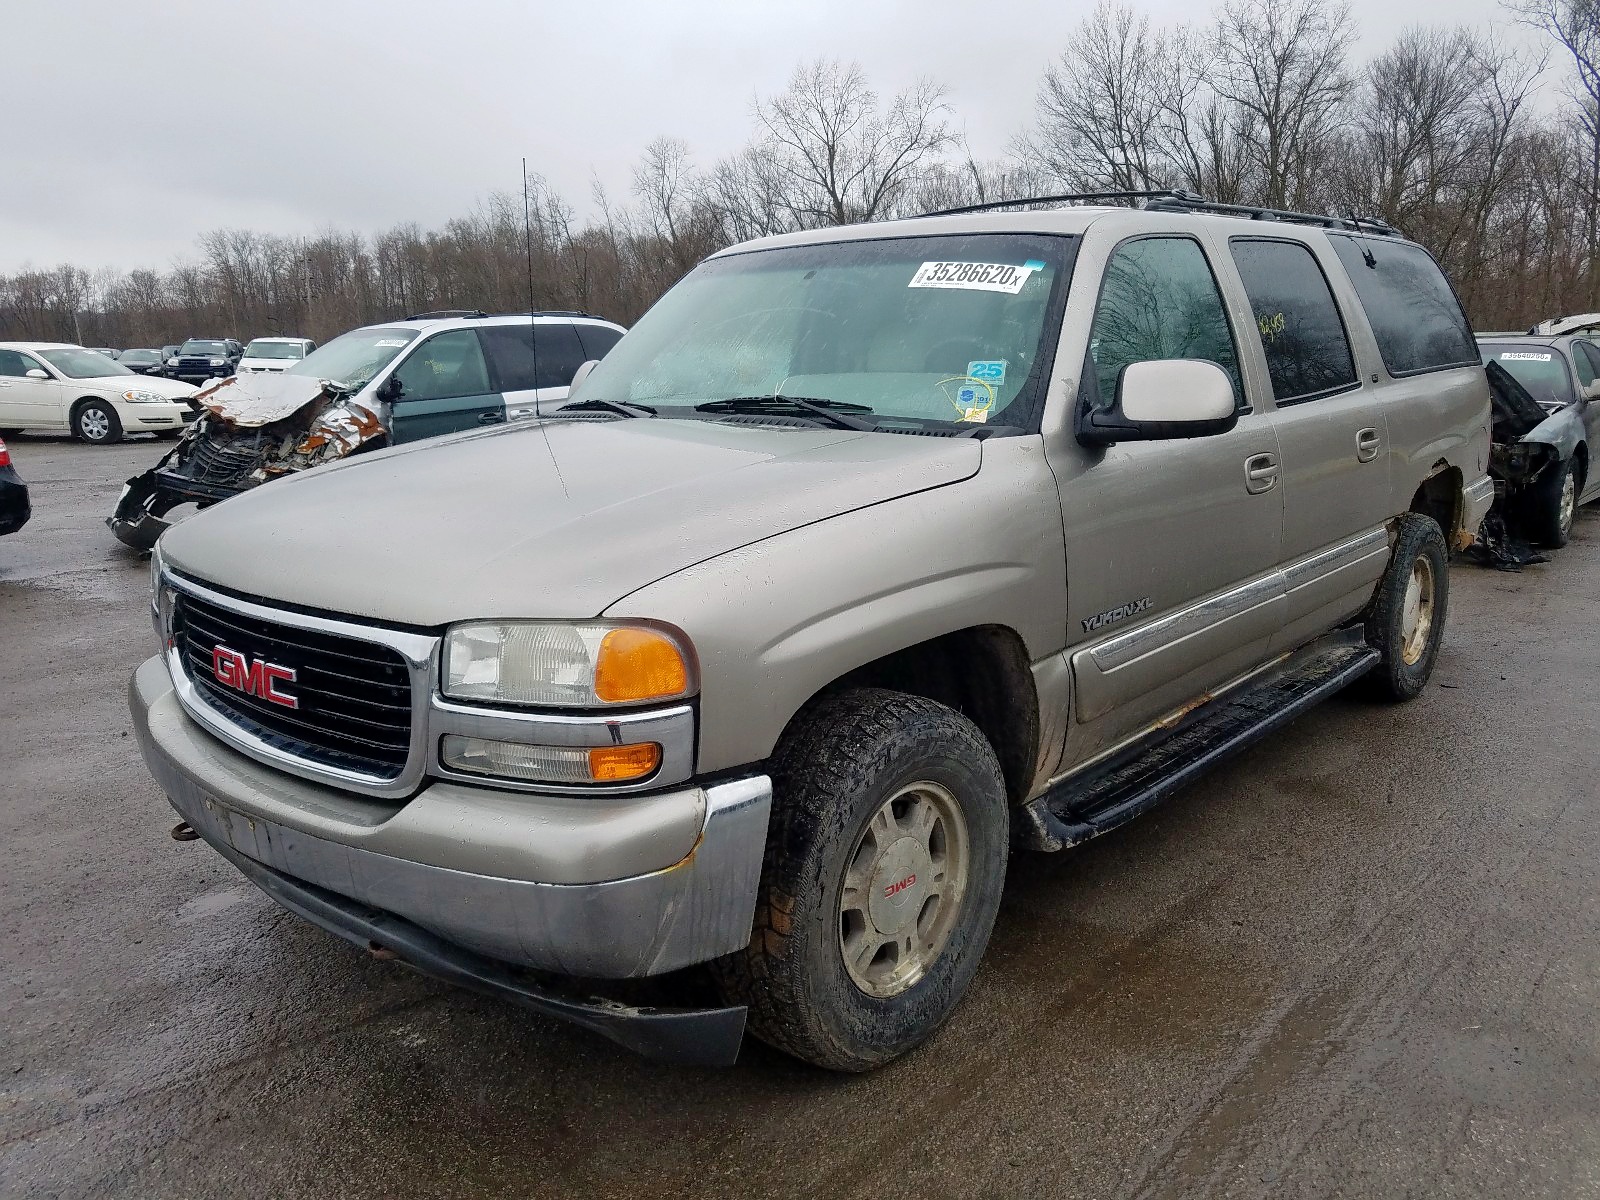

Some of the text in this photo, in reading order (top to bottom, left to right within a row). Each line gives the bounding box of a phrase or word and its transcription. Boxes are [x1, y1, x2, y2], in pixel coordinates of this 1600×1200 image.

[971, 363, 1003, 379] 25
[213, 644, 299, 710] GMC
[884, 874, 916, 899] GMC
